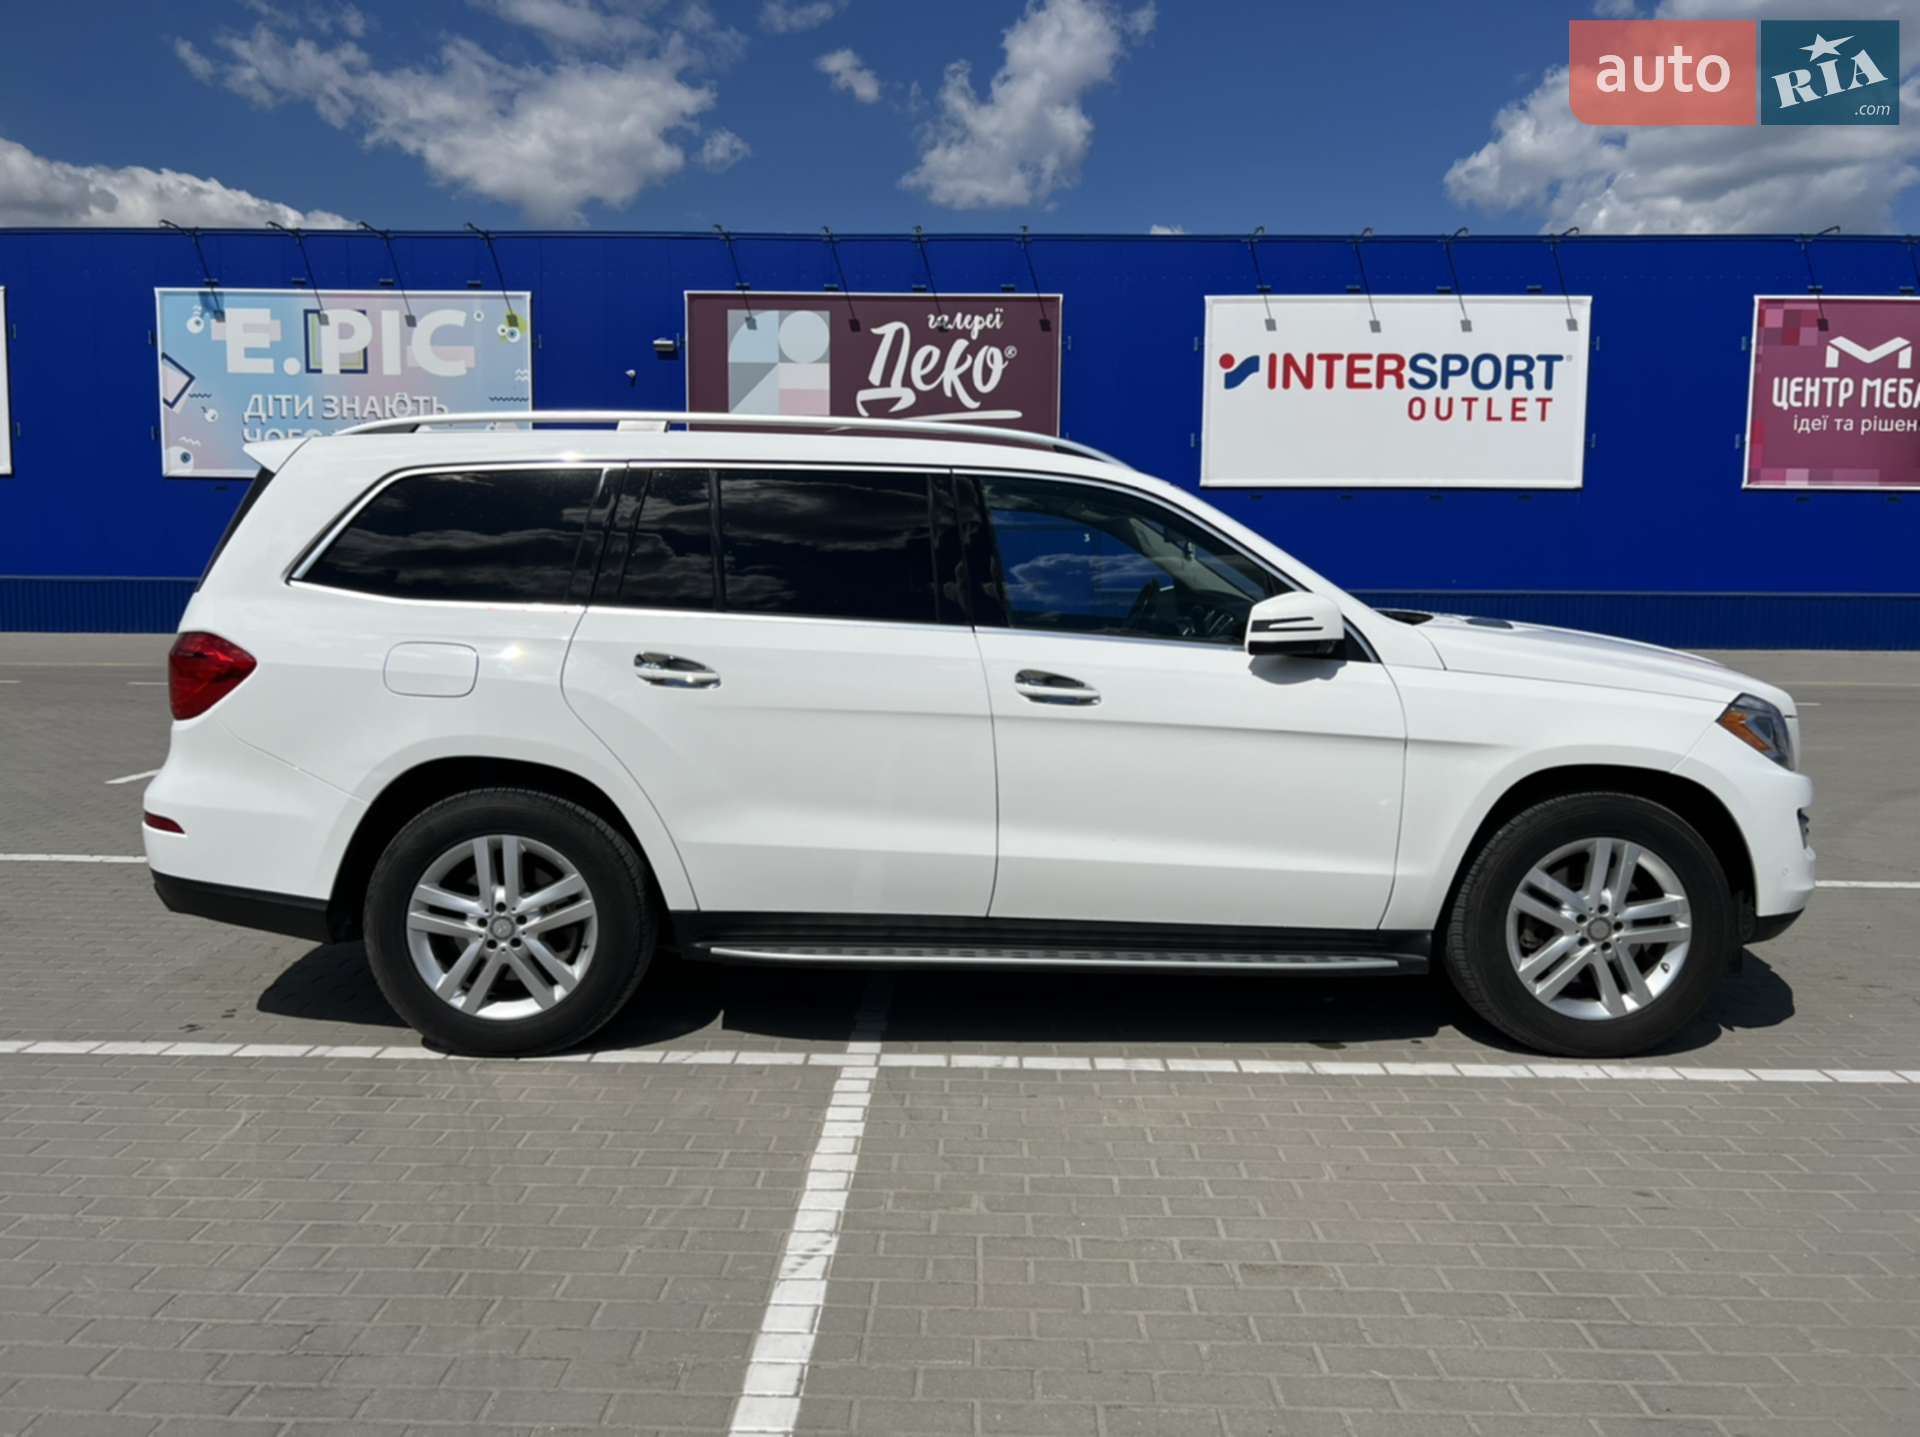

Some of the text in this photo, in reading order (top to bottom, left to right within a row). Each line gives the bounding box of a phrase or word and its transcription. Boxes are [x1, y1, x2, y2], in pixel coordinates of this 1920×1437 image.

[927, 307, 1004, 340] галереї
[225, 307, 468, 377] E.PIC
[1267, 352, 1564, 391] INTERSPORT
[243, 394, 449, 424] ДІТИ ЗНАЮТЬ
[1407, 396, 1553, 422] OUTLET
[1772, 377, 1854, 410] ЦЕНТР
[1793, 415, 1920, 435] ідеї та рішен
